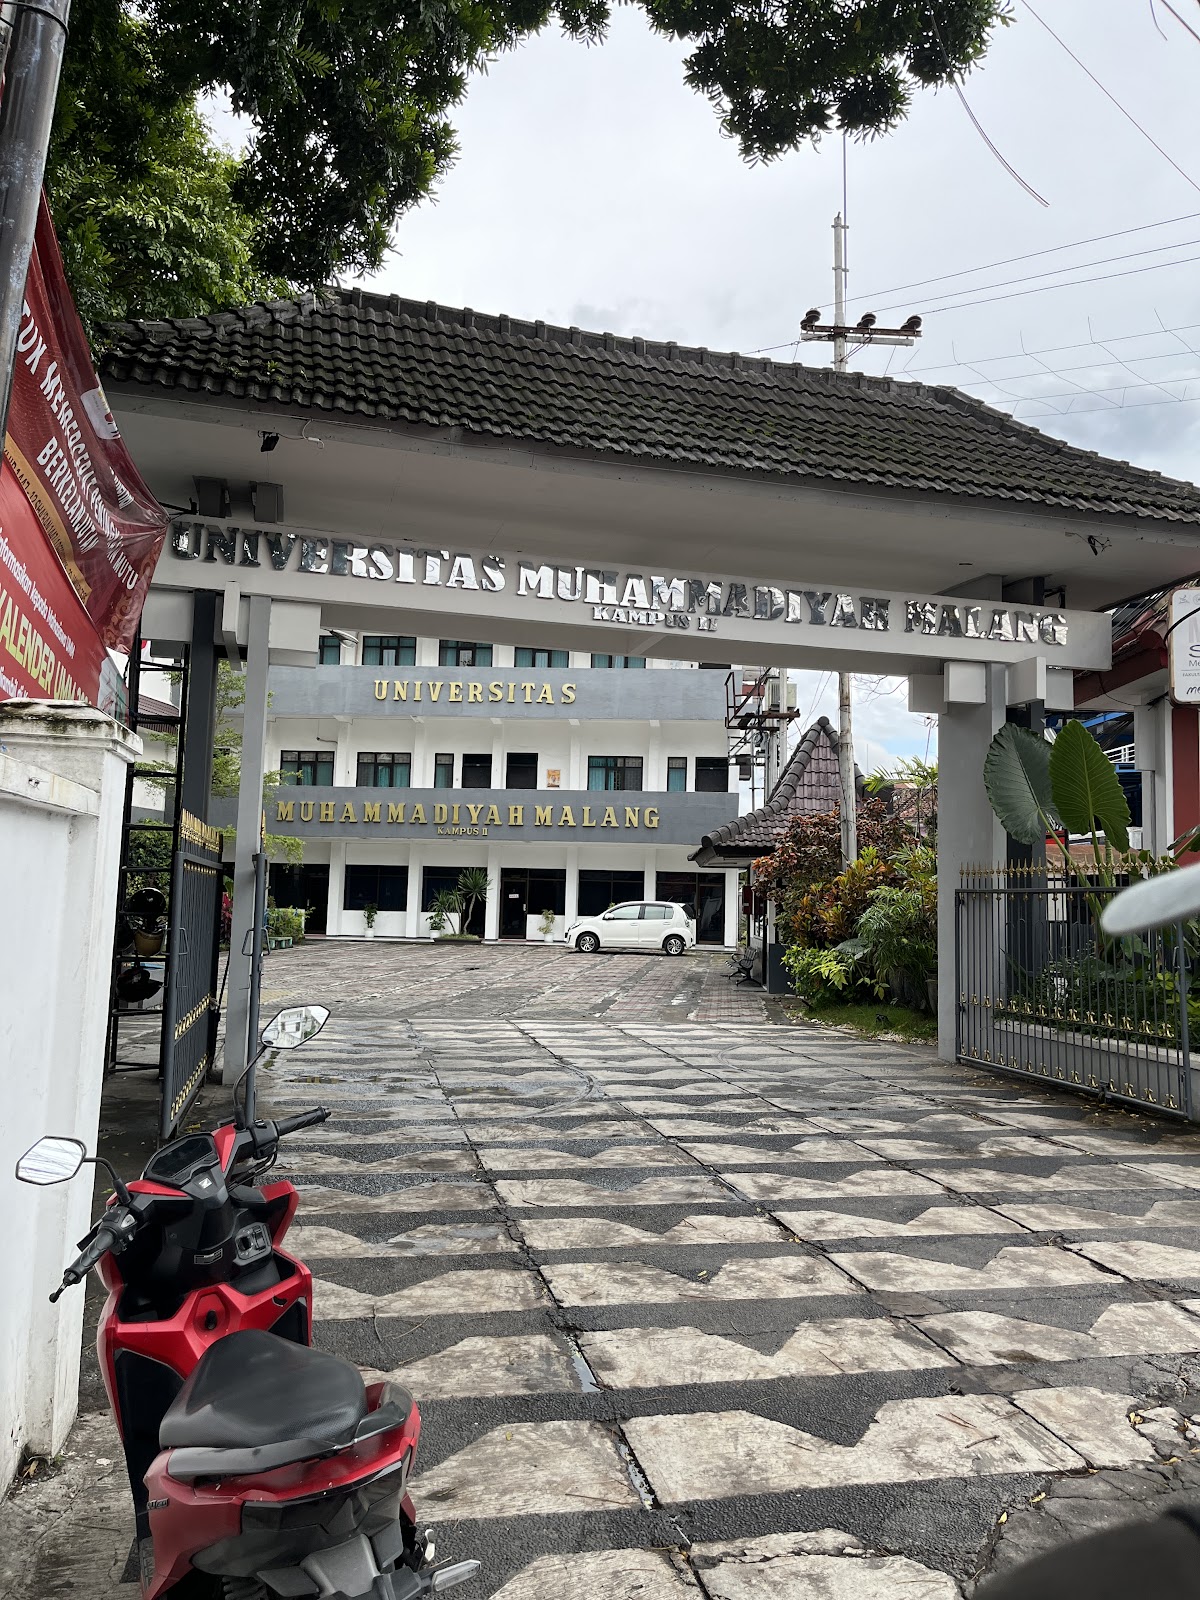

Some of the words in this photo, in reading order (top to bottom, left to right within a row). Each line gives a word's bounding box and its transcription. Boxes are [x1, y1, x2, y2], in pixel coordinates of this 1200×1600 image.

[37, 436, 99, 555] BERKELANJUTAN
[113, 551, 139, 590] MUTU
[171, 520, 506, 593] UNIVERSITAS
[517, 560, 891, 631] MUHAMMADIYAH
[904, 600, 1069, 646] MALANG
[593, 605, 691, 629] KAMPUS
[374, 680, 577, 704] UNIVERSITAS
[276, 801, 524, 827] MUHAMMADIYAH
[534, 805, 660, 829] MALANG
[437, 827, 479, 837] KAMPUS
